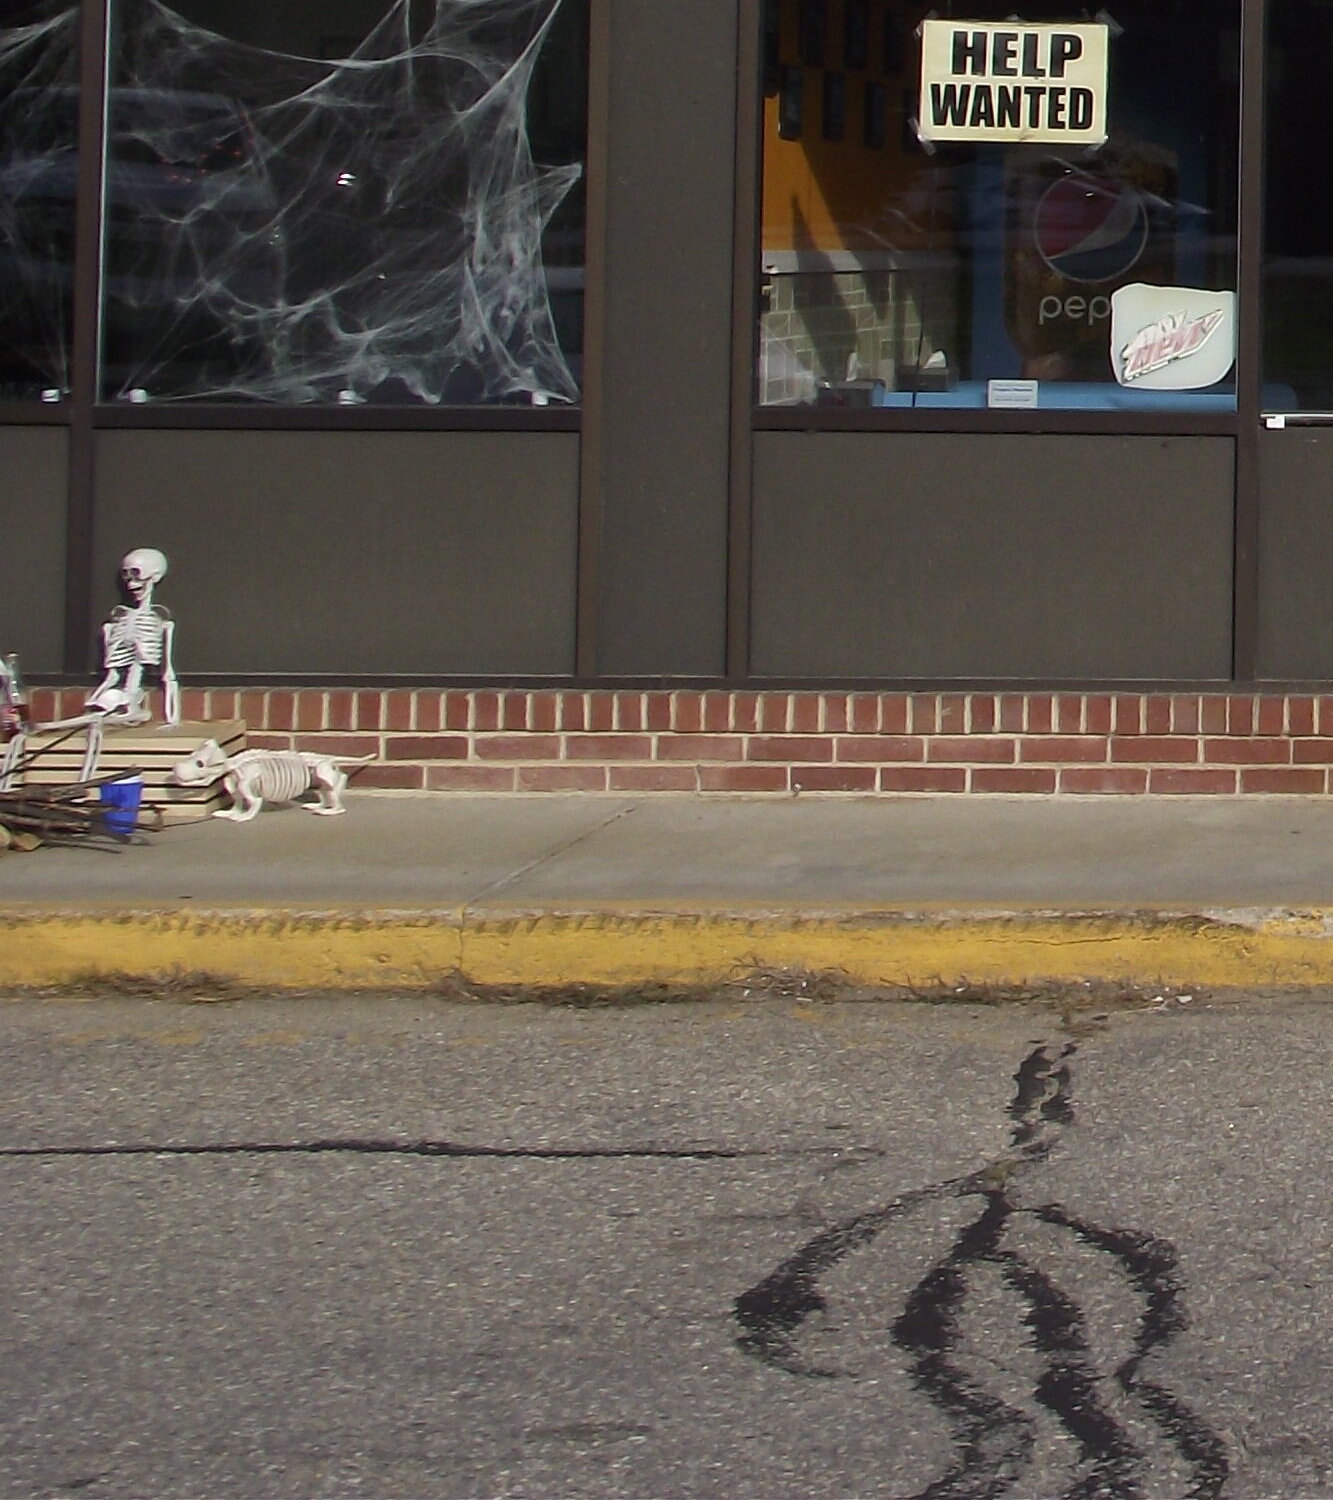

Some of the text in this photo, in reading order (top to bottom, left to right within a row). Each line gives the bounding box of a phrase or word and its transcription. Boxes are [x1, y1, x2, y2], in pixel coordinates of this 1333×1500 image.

[950, 29, 1083, 79] HELP
[929, 82, 1094, 131] WANTED
[1038, 295, 1111, 326] pep
